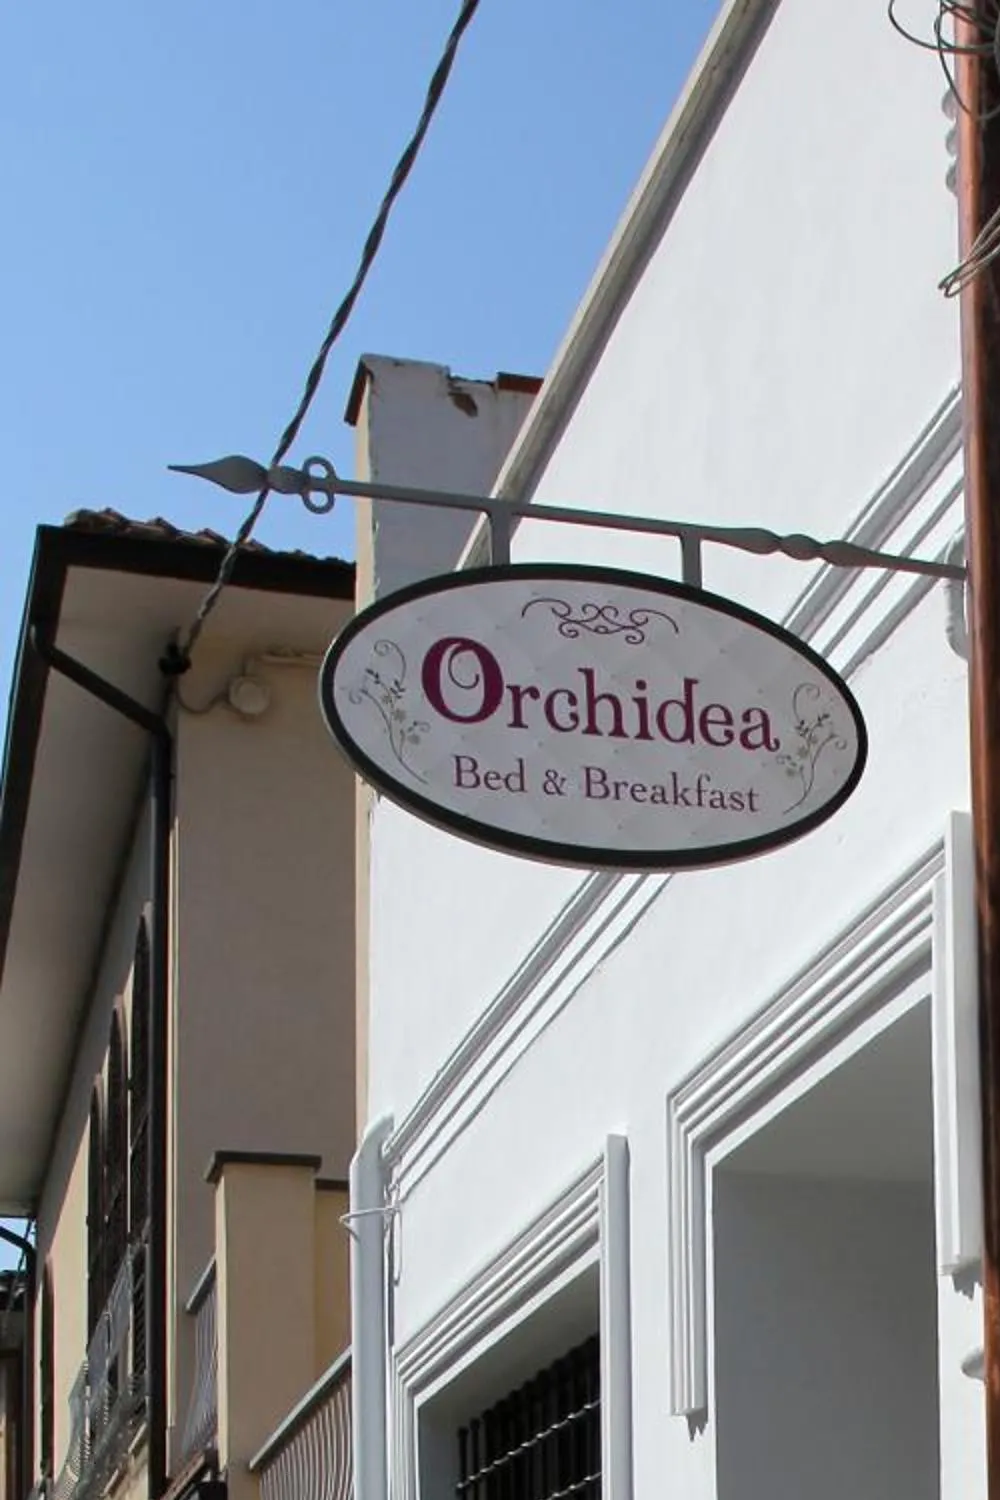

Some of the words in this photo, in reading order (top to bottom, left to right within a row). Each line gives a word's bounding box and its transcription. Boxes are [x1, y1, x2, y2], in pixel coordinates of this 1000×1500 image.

[420, 636, 782, 753] Orchidea
[453, 754, 526, 794] Bed
[542, 768, 566, 796] &
[583, 766, 760, 813] Breakfast
